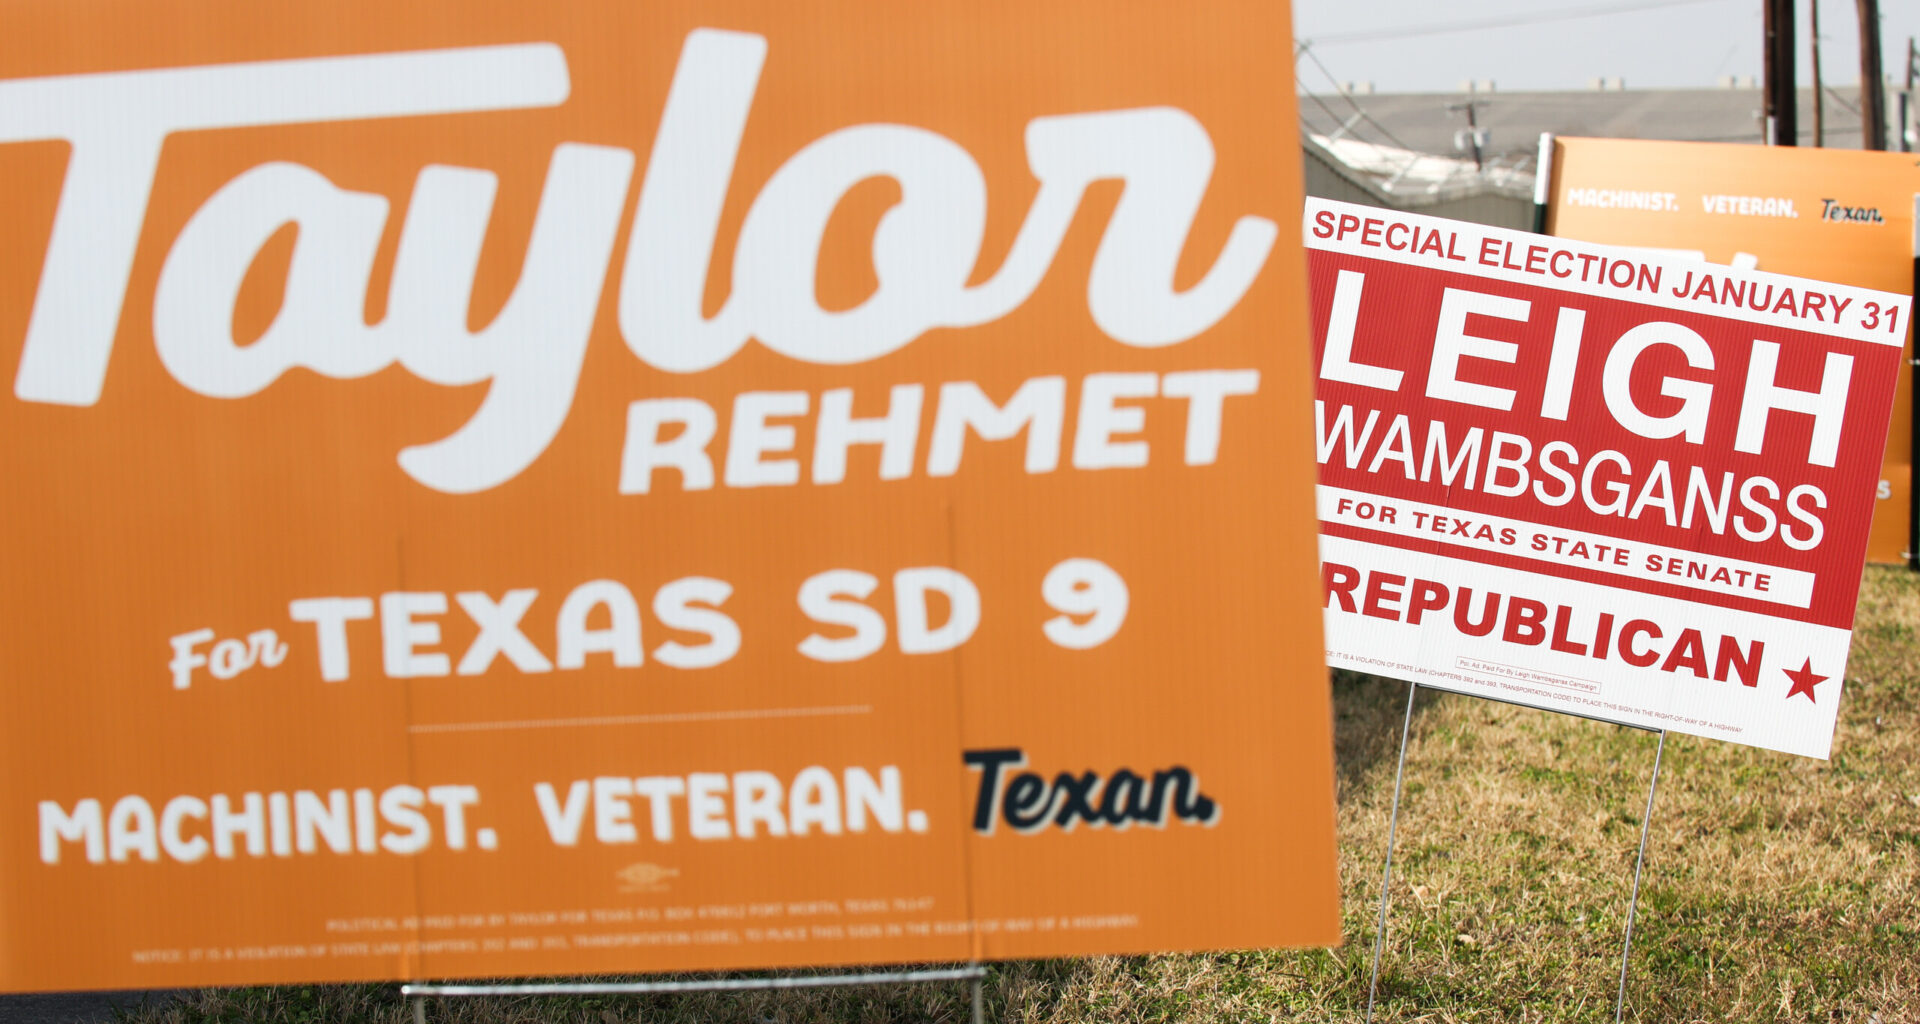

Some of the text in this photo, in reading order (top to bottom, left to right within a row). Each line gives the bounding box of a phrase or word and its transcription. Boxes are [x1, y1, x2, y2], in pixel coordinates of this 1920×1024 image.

[0, 27, 1278, 494] Taylor
[1567, 187, 1885, 225] MACHINIST. VETERAN. Texan.
[1313, 211, 1899, 333] SPECIAL ELECTION JANUARY 31
[1320, 269, 1854, 468] LEIGH
[619, 369, 1260, 495] REHMET
[1315, 400, 1827, 550] WAMBSGANSS
[1338, 499, 1770, 591] FOR TEXAS STATE SENATE
[169, 558, 1130, 690] For TEXAS SD 9
[1322, 562, 1764, 687] REPUBLICAN
[1481, 663, 1494, 672] Paid
[1495, 666, 1505, 674] For
[1514, 670, 1529, 678] Leigh
[1567, 680, 1597, 691] Campaign
[1354, 655, 1385, 667] VIOLATION
[1386, 661, 1395, 669] OF
[1395, 663, 1413, 672] STATE
[1414, 666, 1427, 675] LAW
[1499, 682, 1552, 698] TRANSPORTATION
[1572, 695, 1582, 703] TO
[1581, 697, 1602, 707] PLACE
[1603, 701, 1617, 710] THIS
[1617, 704, 1633, 713] SIGN
[1641, 708, 1653, 717] THE
[1653, 711, 1698, 725] RIGHT-OF-WAY
[1698, 719, 1707, 727] OF
[1713, 722, 1743, 733] HIGHWAY
[38, 748, 1221, 864] MACHINIST. VETERAN. Texan.
